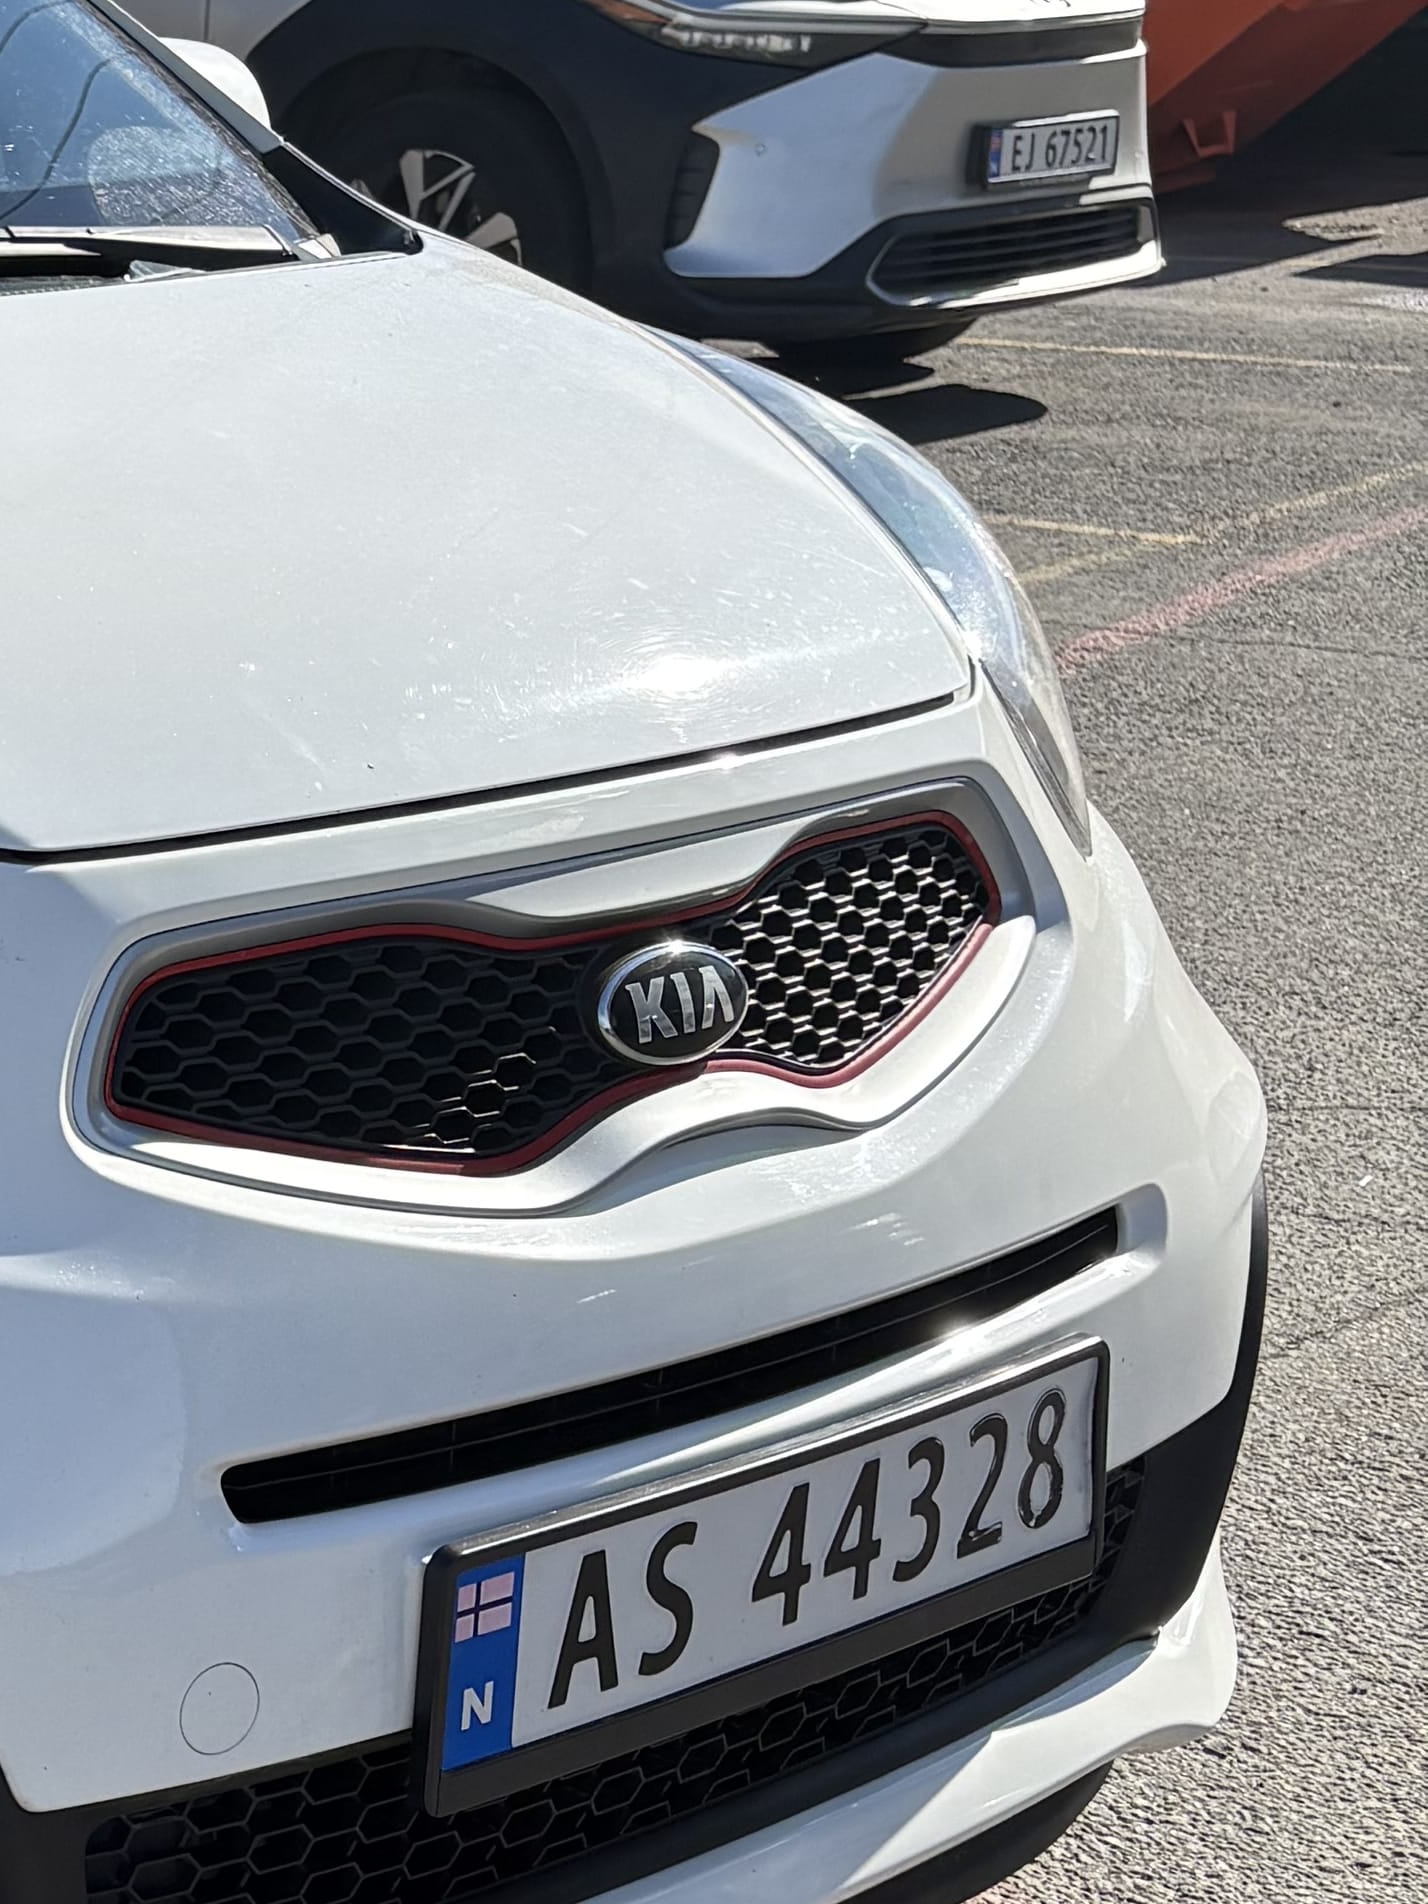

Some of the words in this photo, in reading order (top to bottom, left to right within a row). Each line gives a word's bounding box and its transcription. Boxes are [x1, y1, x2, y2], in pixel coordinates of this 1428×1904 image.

[1011, 132, 1036, 173] EJ
[1045, 124, 1108, 168] 67521
[625, 965, 734, 1044] KIA
[548, 1521, 698, 1710] AS
[752, 1388, 1067, 1627] 44328
[460, 1681, 495, 1732] N
